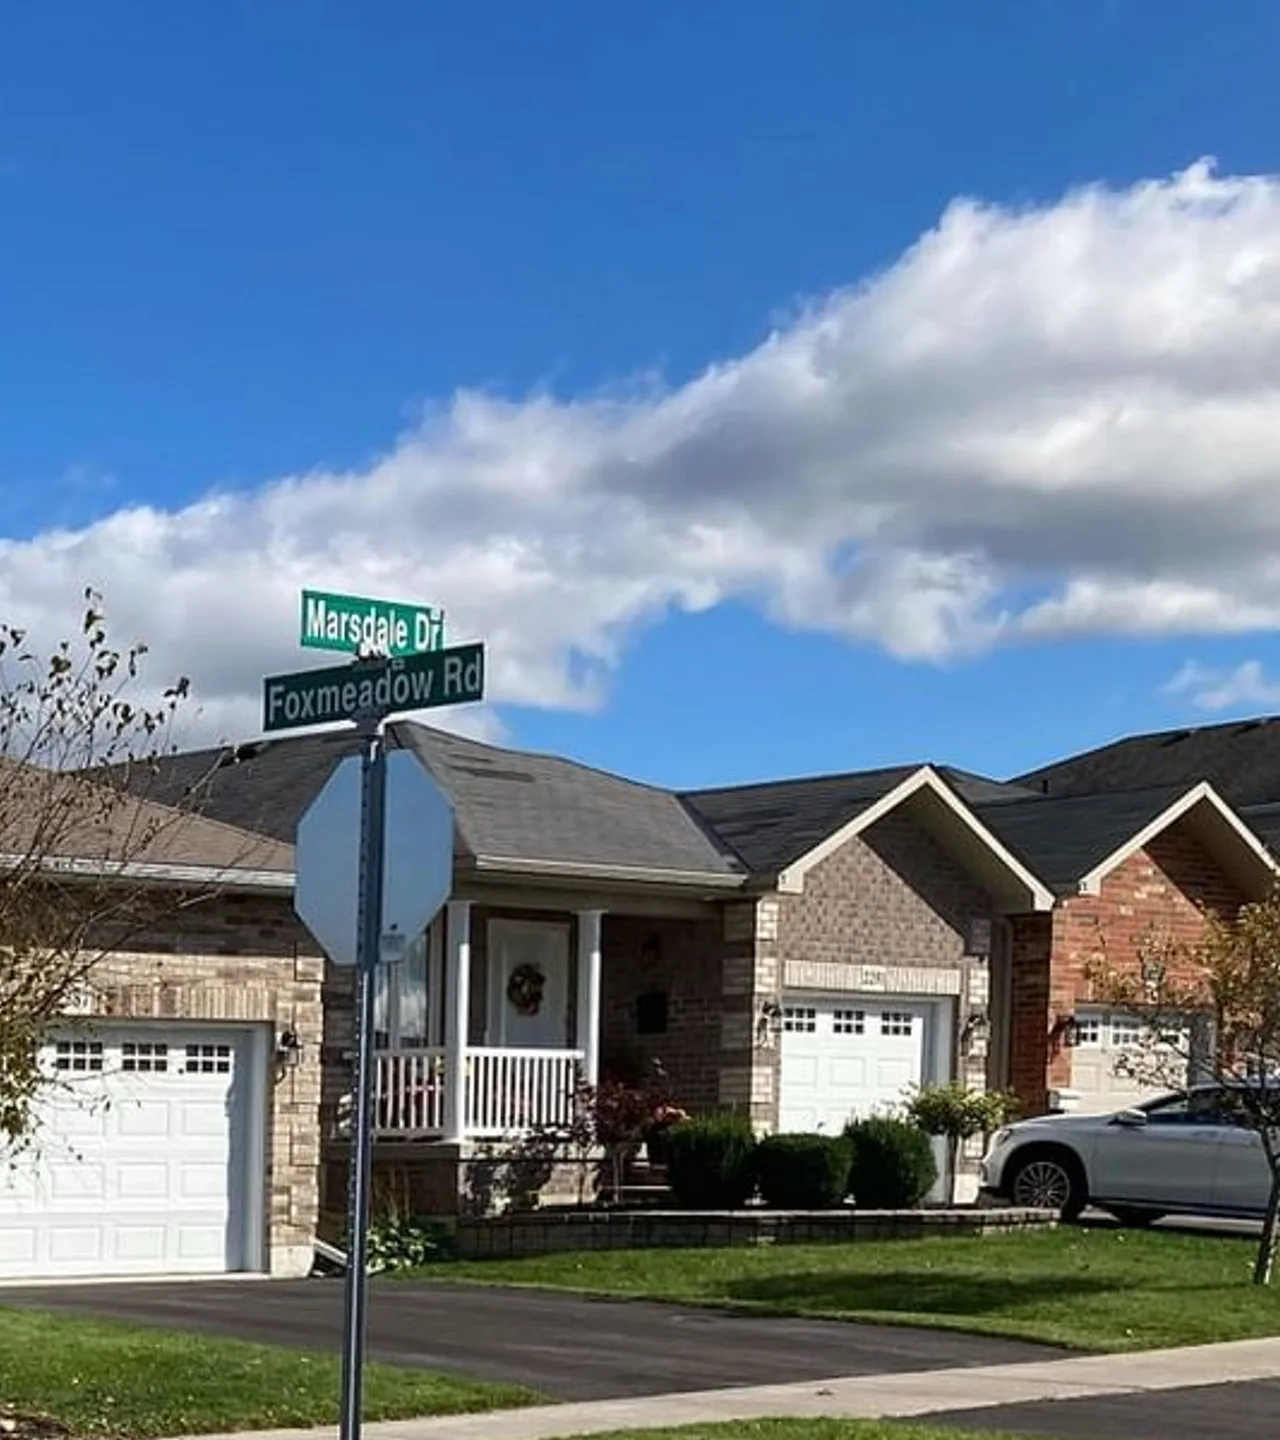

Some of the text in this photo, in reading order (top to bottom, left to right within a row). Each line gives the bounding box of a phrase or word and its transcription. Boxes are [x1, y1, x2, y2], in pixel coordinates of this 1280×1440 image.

[306, 598, 440, 651] Marsdale Dr
[268, 653, 481, 723] Foxmeadow Rd
